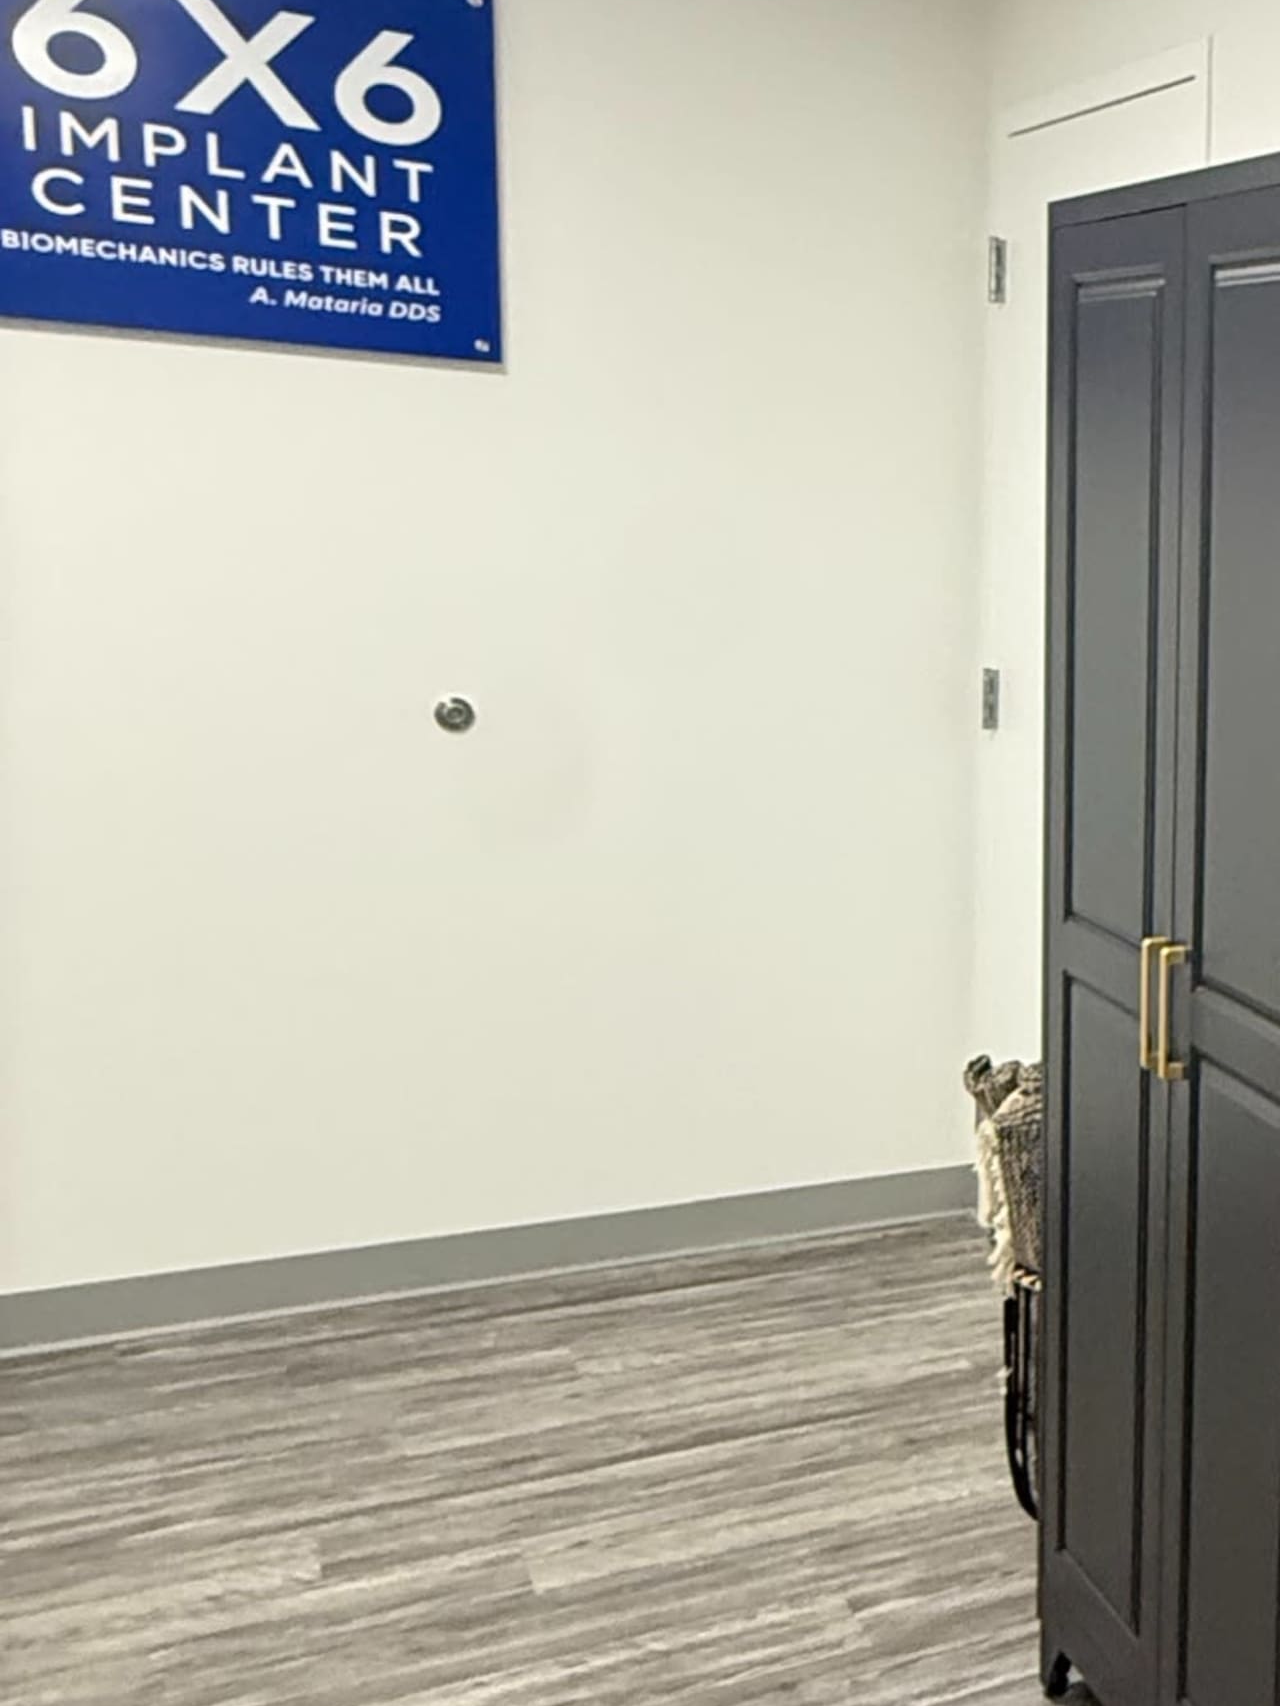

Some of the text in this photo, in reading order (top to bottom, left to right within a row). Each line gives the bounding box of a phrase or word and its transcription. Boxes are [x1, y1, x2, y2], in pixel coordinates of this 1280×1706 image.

[22, 105, 433, 202] IMPLANT
[31, 168, 422, 257] CENTER
[1, 229, 440, 296] BIOMECHANICS RULES THEM ALL
[249, 286, 441, 323] A. Mataria DDS
